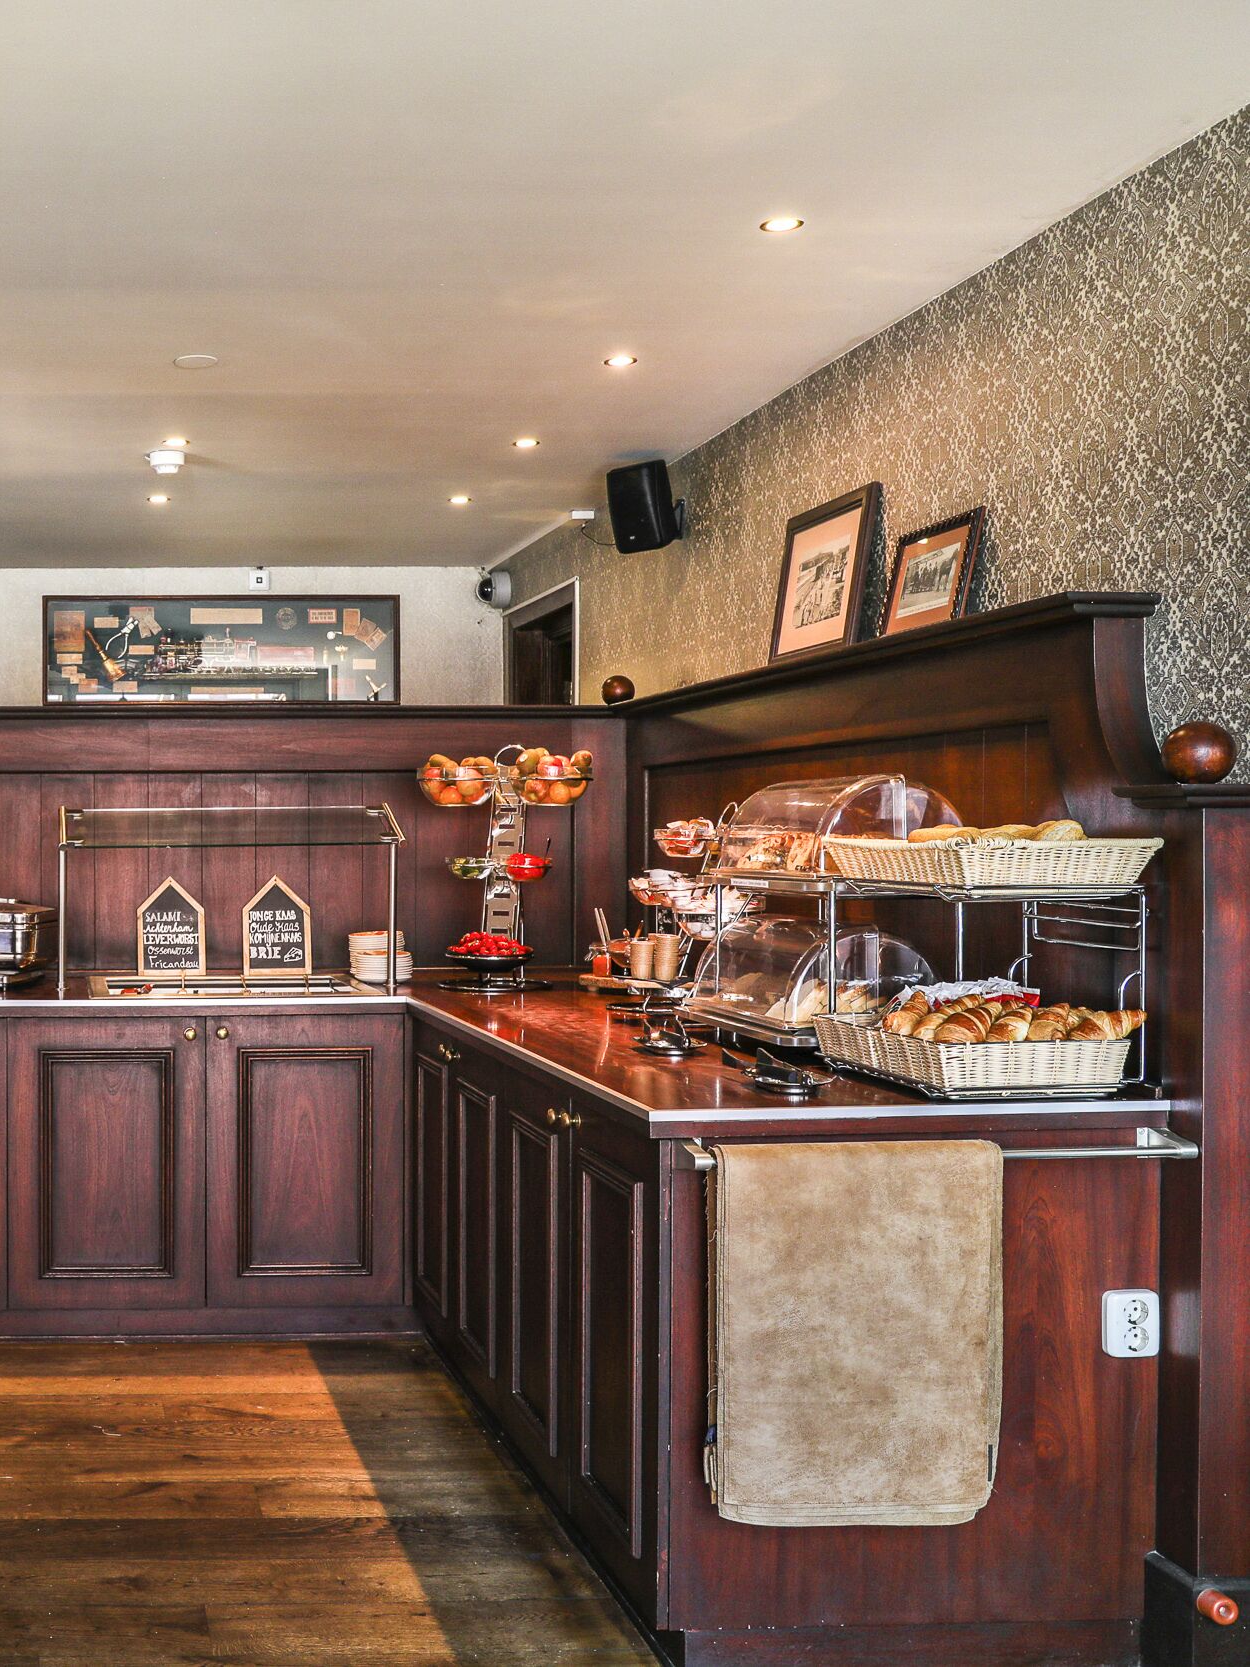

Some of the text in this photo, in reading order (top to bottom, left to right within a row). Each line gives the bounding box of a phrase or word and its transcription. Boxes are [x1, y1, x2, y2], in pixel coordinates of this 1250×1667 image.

[145, 911, 181, 922] SALAMI
[248, 910, 297, 923] JONGE KAAS
[250, 922, 274, 933] Oude
[143, 933, 199, 945] LEVERWORST
[249, 946, 282, 959] BRIE
[149, 955, 199, 969] Fricandeau
